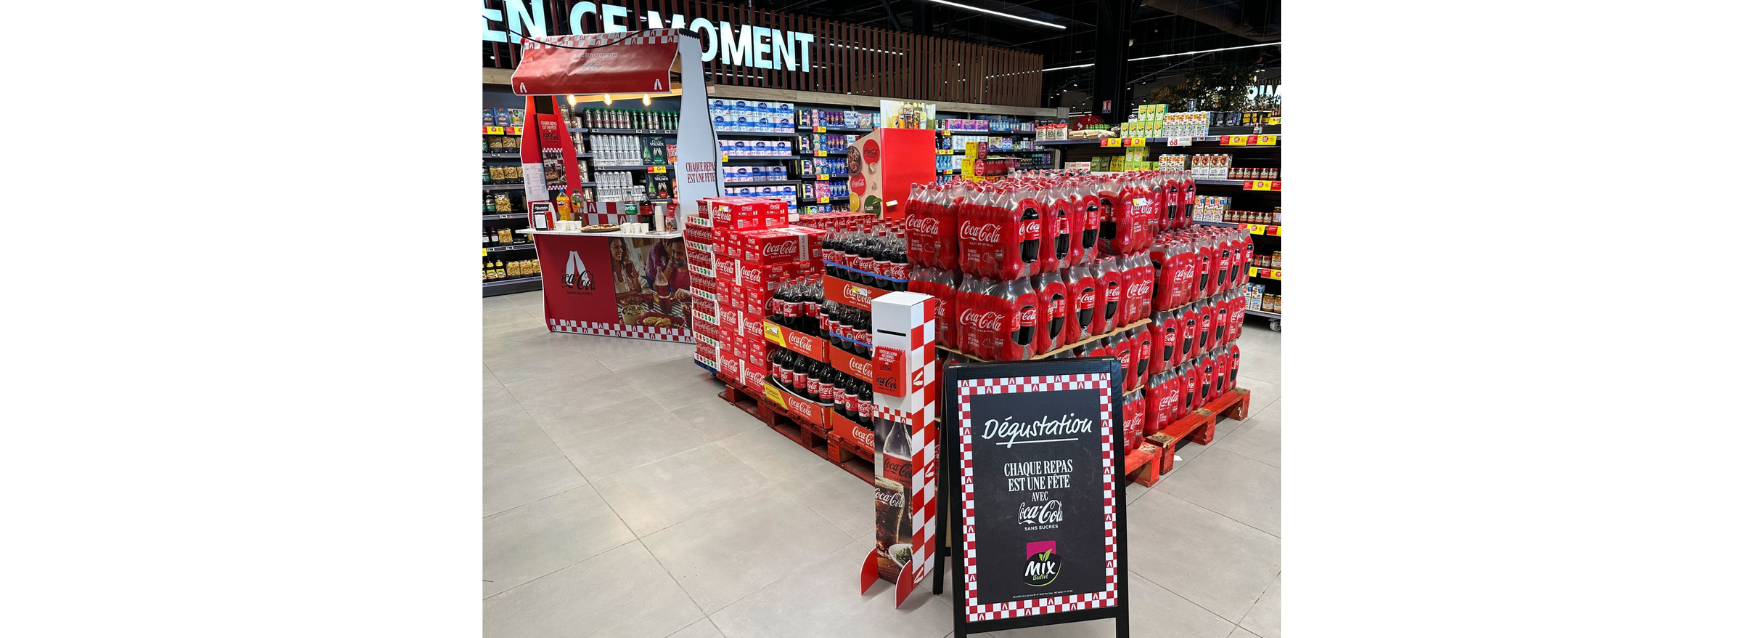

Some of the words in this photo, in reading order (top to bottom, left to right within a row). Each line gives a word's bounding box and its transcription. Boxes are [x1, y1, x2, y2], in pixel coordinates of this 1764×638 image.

[482, 0, 547, 44] EN
[569, 1, 628, 35] CE
[686, 161, 703, 172] CHAQUE
[687, 173, 696, 183] EST
[696, 173, 705, 183] UNE
[905, 213, 940, 235] Coca-Cola
[960, 220, 1002, 243] Coca-Cola
[762, 239, 798, 257] Coca-Cola
[715, 258, 734, 274] Coca-Cola
[740, 265, 762, 283] Coca-Cola
[743, 317, 763, 336] Coca-Cola
[959, 307, 1005, 332] Coca-Cola
[788, 331, 812, 352] Coca-Cola
[788, 396, 812, 417] Coca-Cola
[981, 413, 1093, 448] Dégustation
[1004, 461, 1042, 477] CHAQUE
[1044, 459, 1073, 475] REPAS
[1008, 477, 1026, 492] EST
[1026, 476, 1046, 491] UNE
[1047, 473, 1071, 489] FÊTE
[1031, 491, 1049, 501] AVEC
